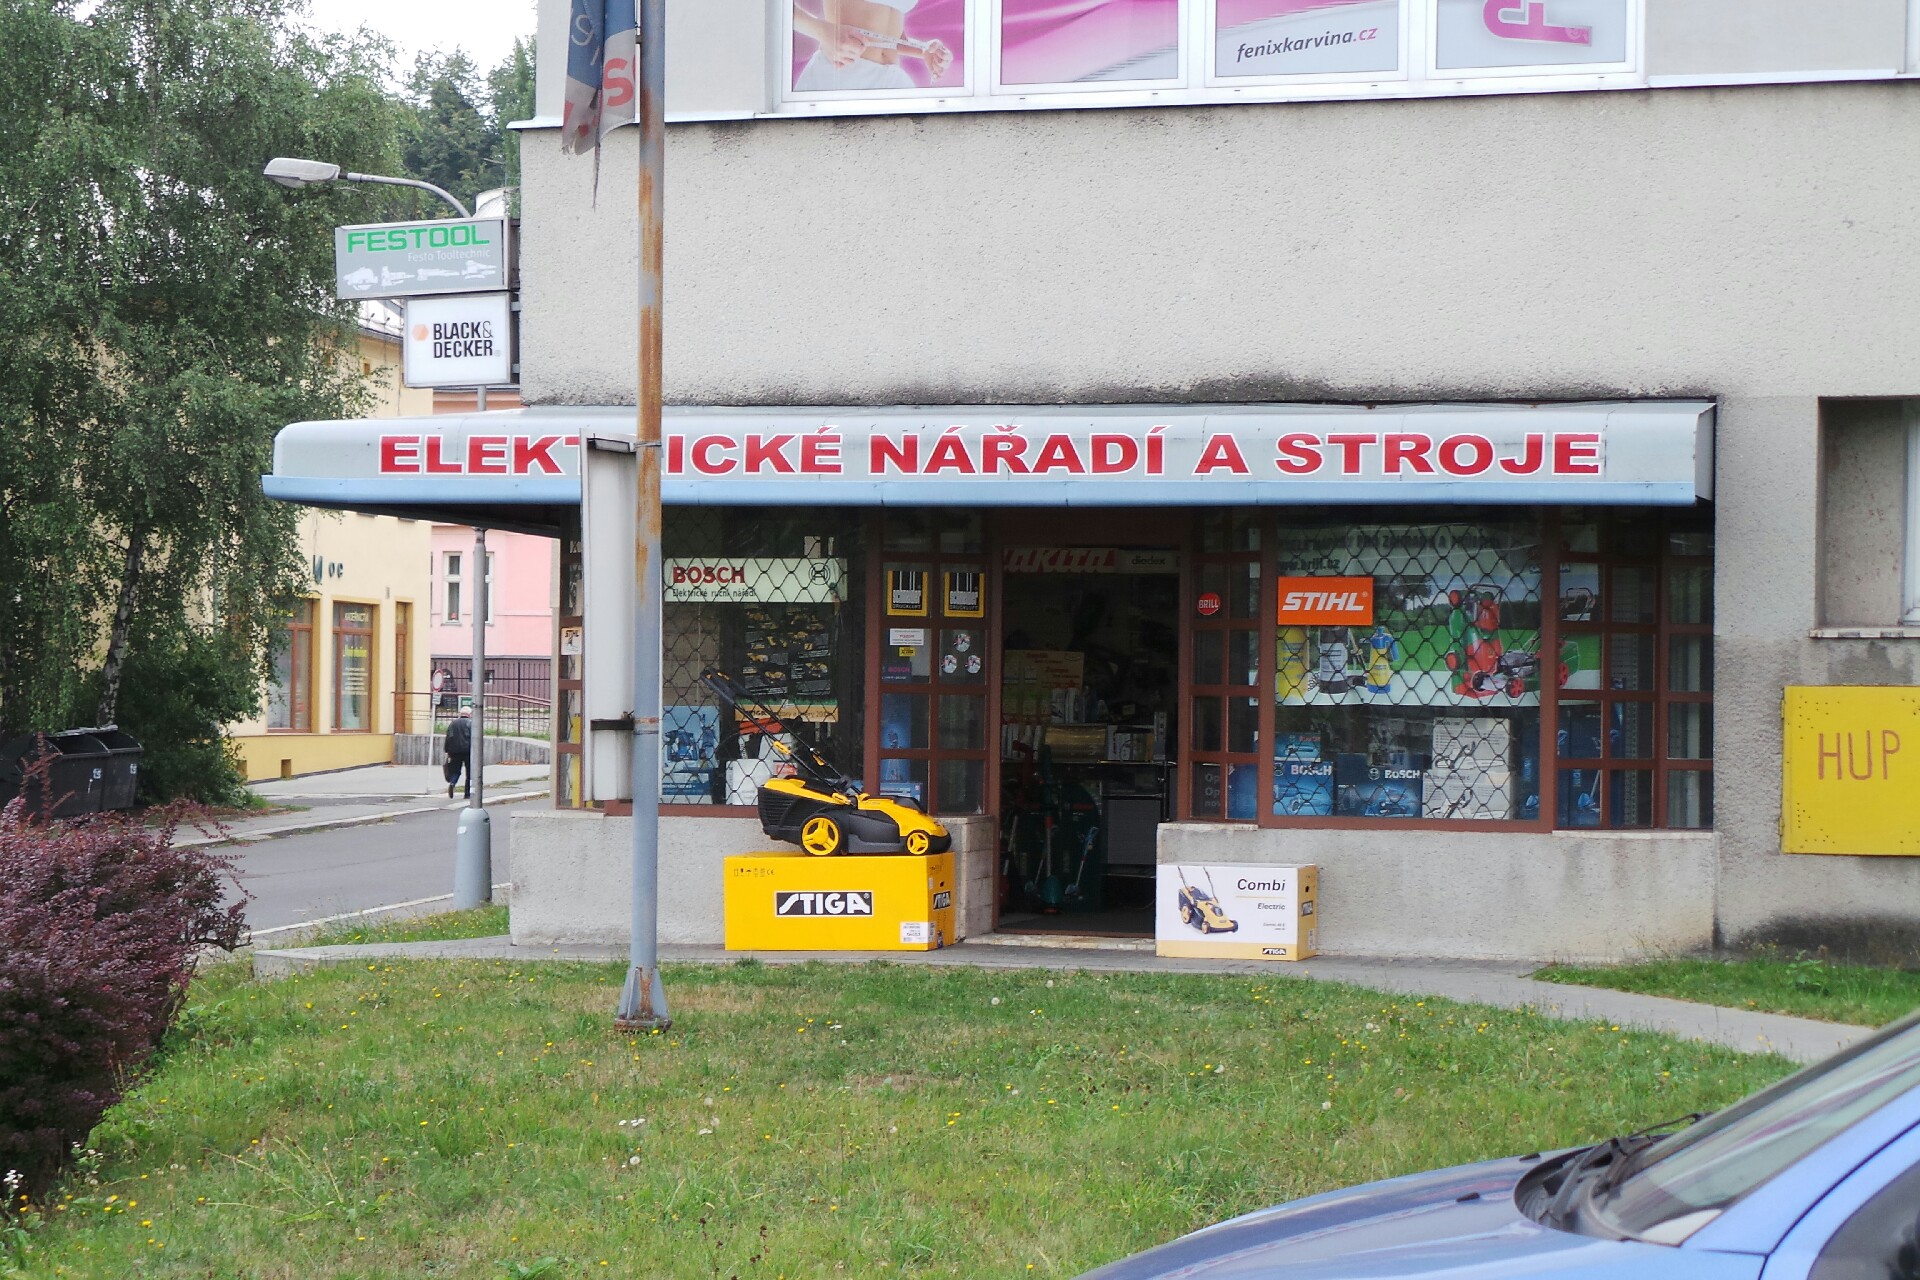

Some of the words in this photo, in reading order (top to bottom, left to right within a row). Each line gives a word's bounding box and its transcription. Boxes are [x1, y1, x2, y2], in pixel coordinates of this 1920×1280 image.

[1237, 27, 1379, 63] fenixkarvina.cz
[347, 224, 491, 253] FESTOOL
[407, 252, 434, 262] Festo
[436, 248, 491, 261] Tooltechnic
[433, 340, 493, 358] DECKER
[379, 425, 844, 476] ELEKICKÉ
[869, 424, 1172, 476] NÁŘADÍ
[1192, 432, 1252, 476] A
[1274, 431, 1602, 476] STROJE
[673, 566, 746, 584] BOSCH
[1198, 598, 1219, 610] BRILL
[1282, 592, 1365, 611] STIHL
[1817, 729, 1901, 780] HUP
[1290, 764, 1332, 777] BOSCH
[1384, 769, 1421, 779] BOSCH
[1237, 878, 1286, 892] Combi
[778, 892, 871, 915] STIGA
[1257, 902, 1286, 911] Electric
[1262, 948, 1287, 956] STIGA
